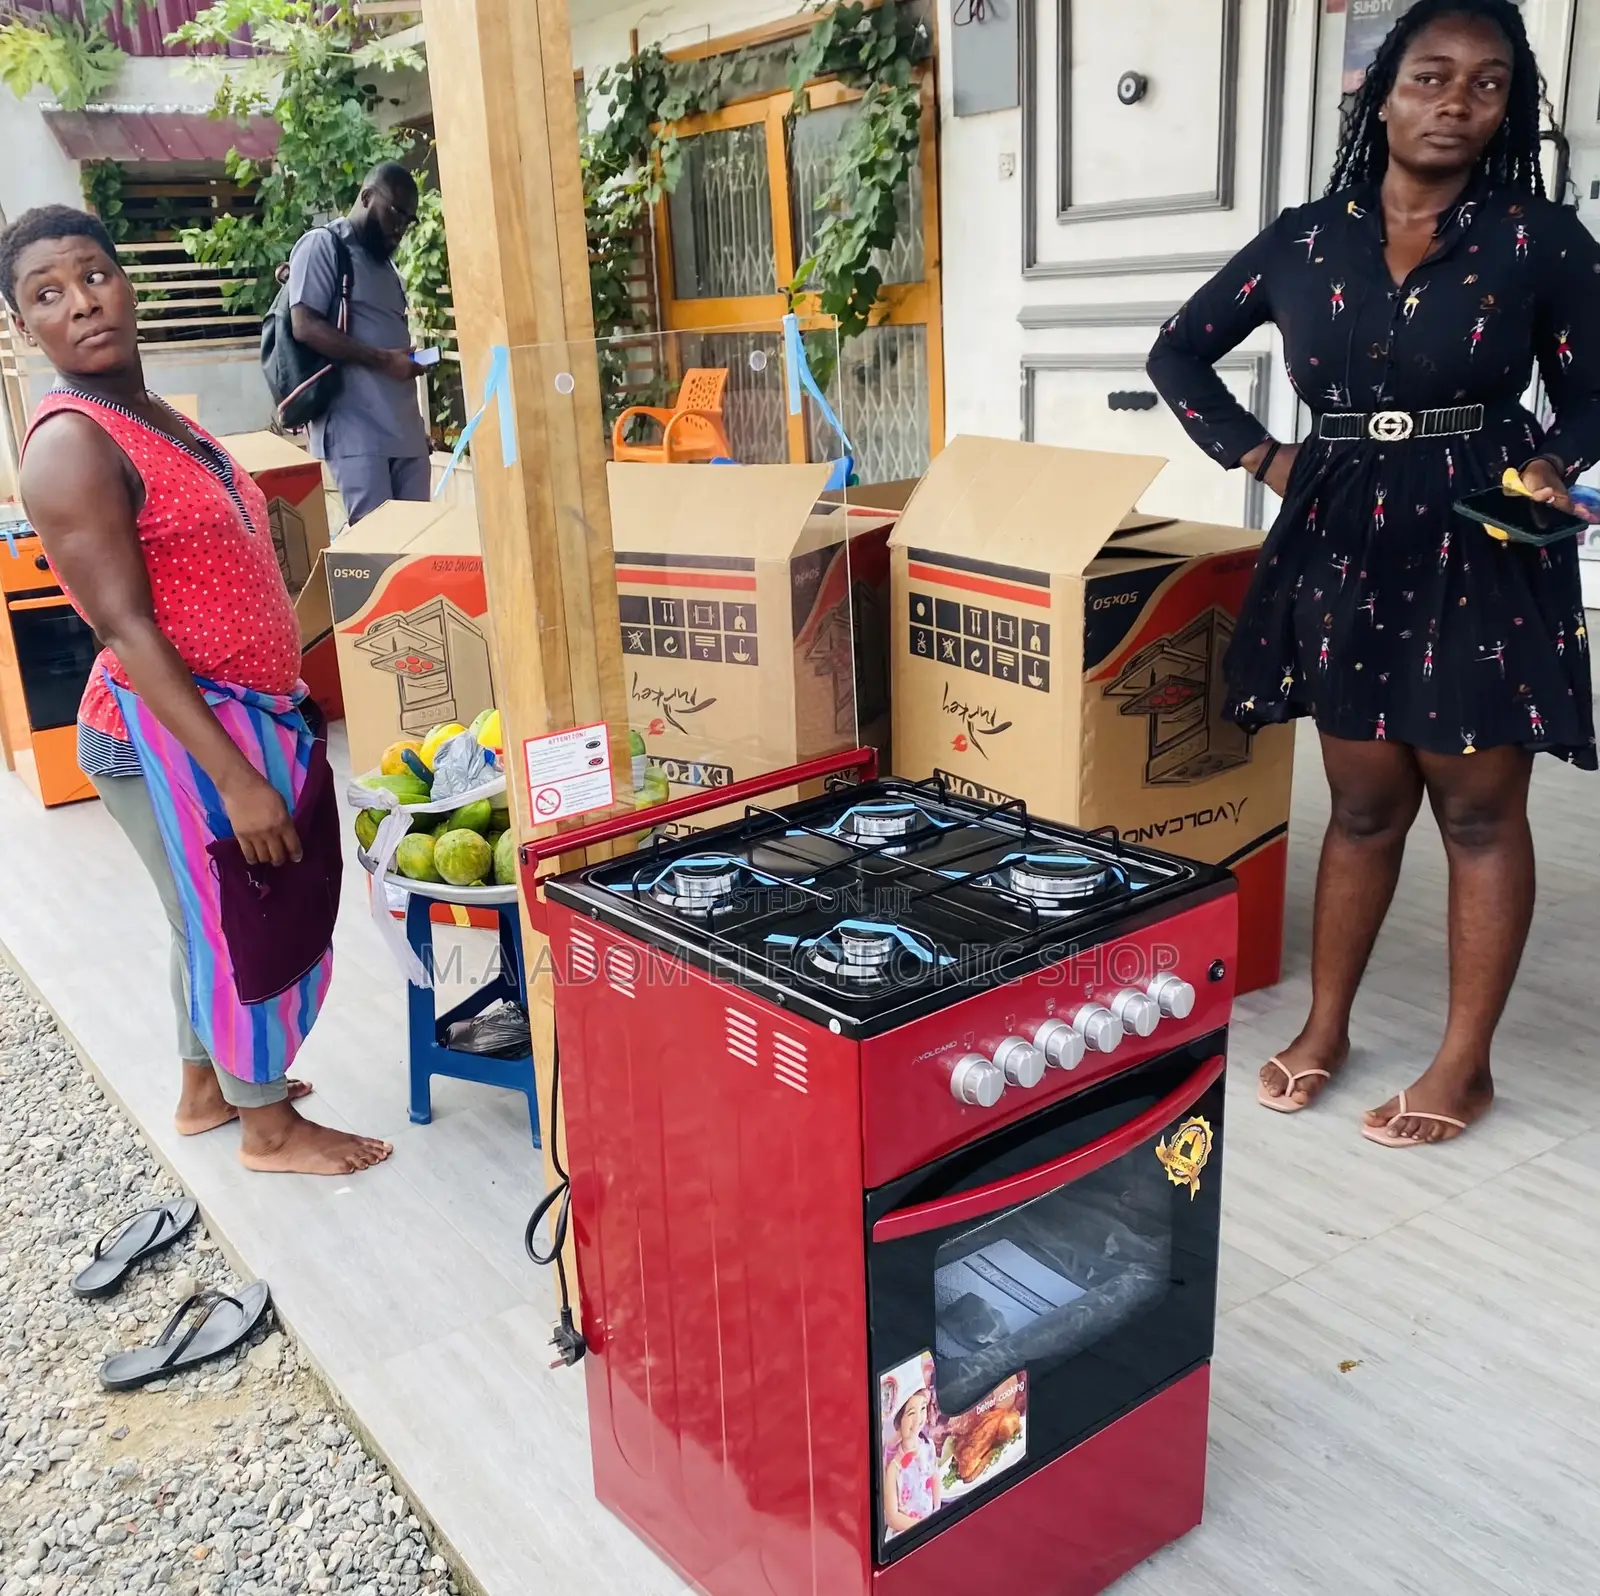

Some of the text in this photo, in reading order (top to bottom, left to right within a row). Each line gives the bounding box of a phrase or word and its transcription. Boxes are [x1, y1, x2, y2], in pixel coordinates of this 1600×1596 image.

[333, 567, 371, 579] 50x50
[1093, 590, 1139, 610] 50x50
[918, 1040, 958, 1060] VOLCANO
